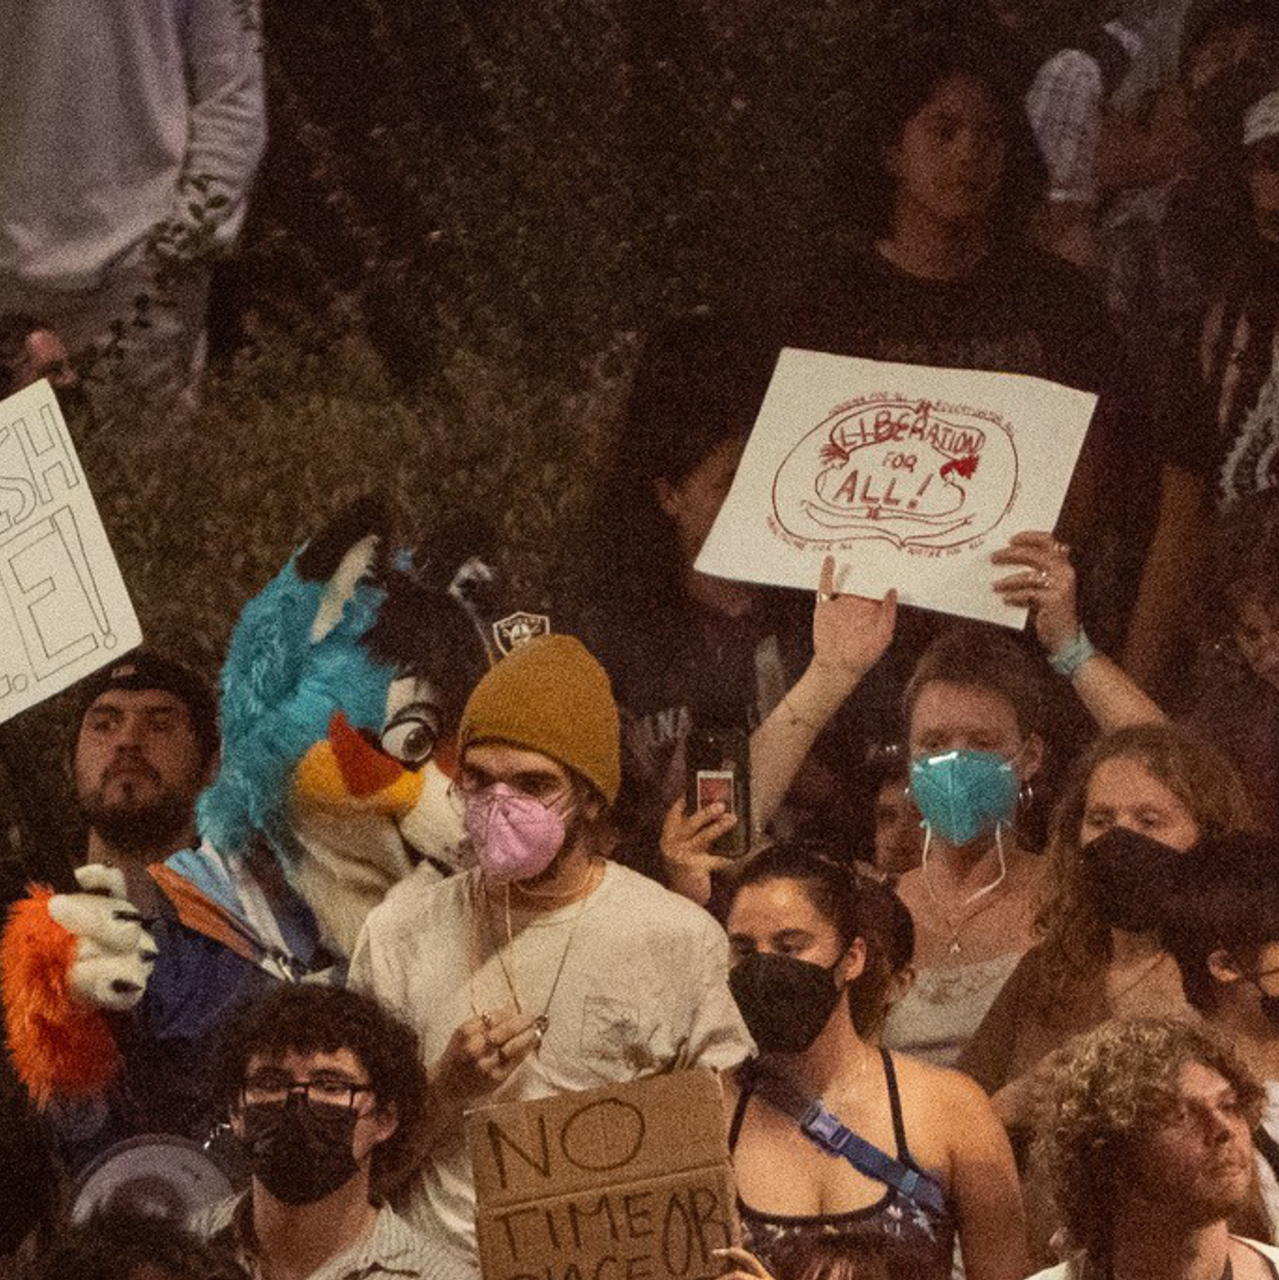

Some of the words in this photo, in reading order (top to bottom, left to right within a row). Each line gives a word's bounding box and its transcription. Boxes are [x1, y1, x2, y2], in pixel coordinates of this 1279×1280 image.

[838, 409, 983, 456] LIBERATION
[832, 472, 935, 511] ALL!
[486, 1097, 647, 1190] NO
[494, 1191, 656, 1262] TIME
[661, 1185, 733, 1277] OR
